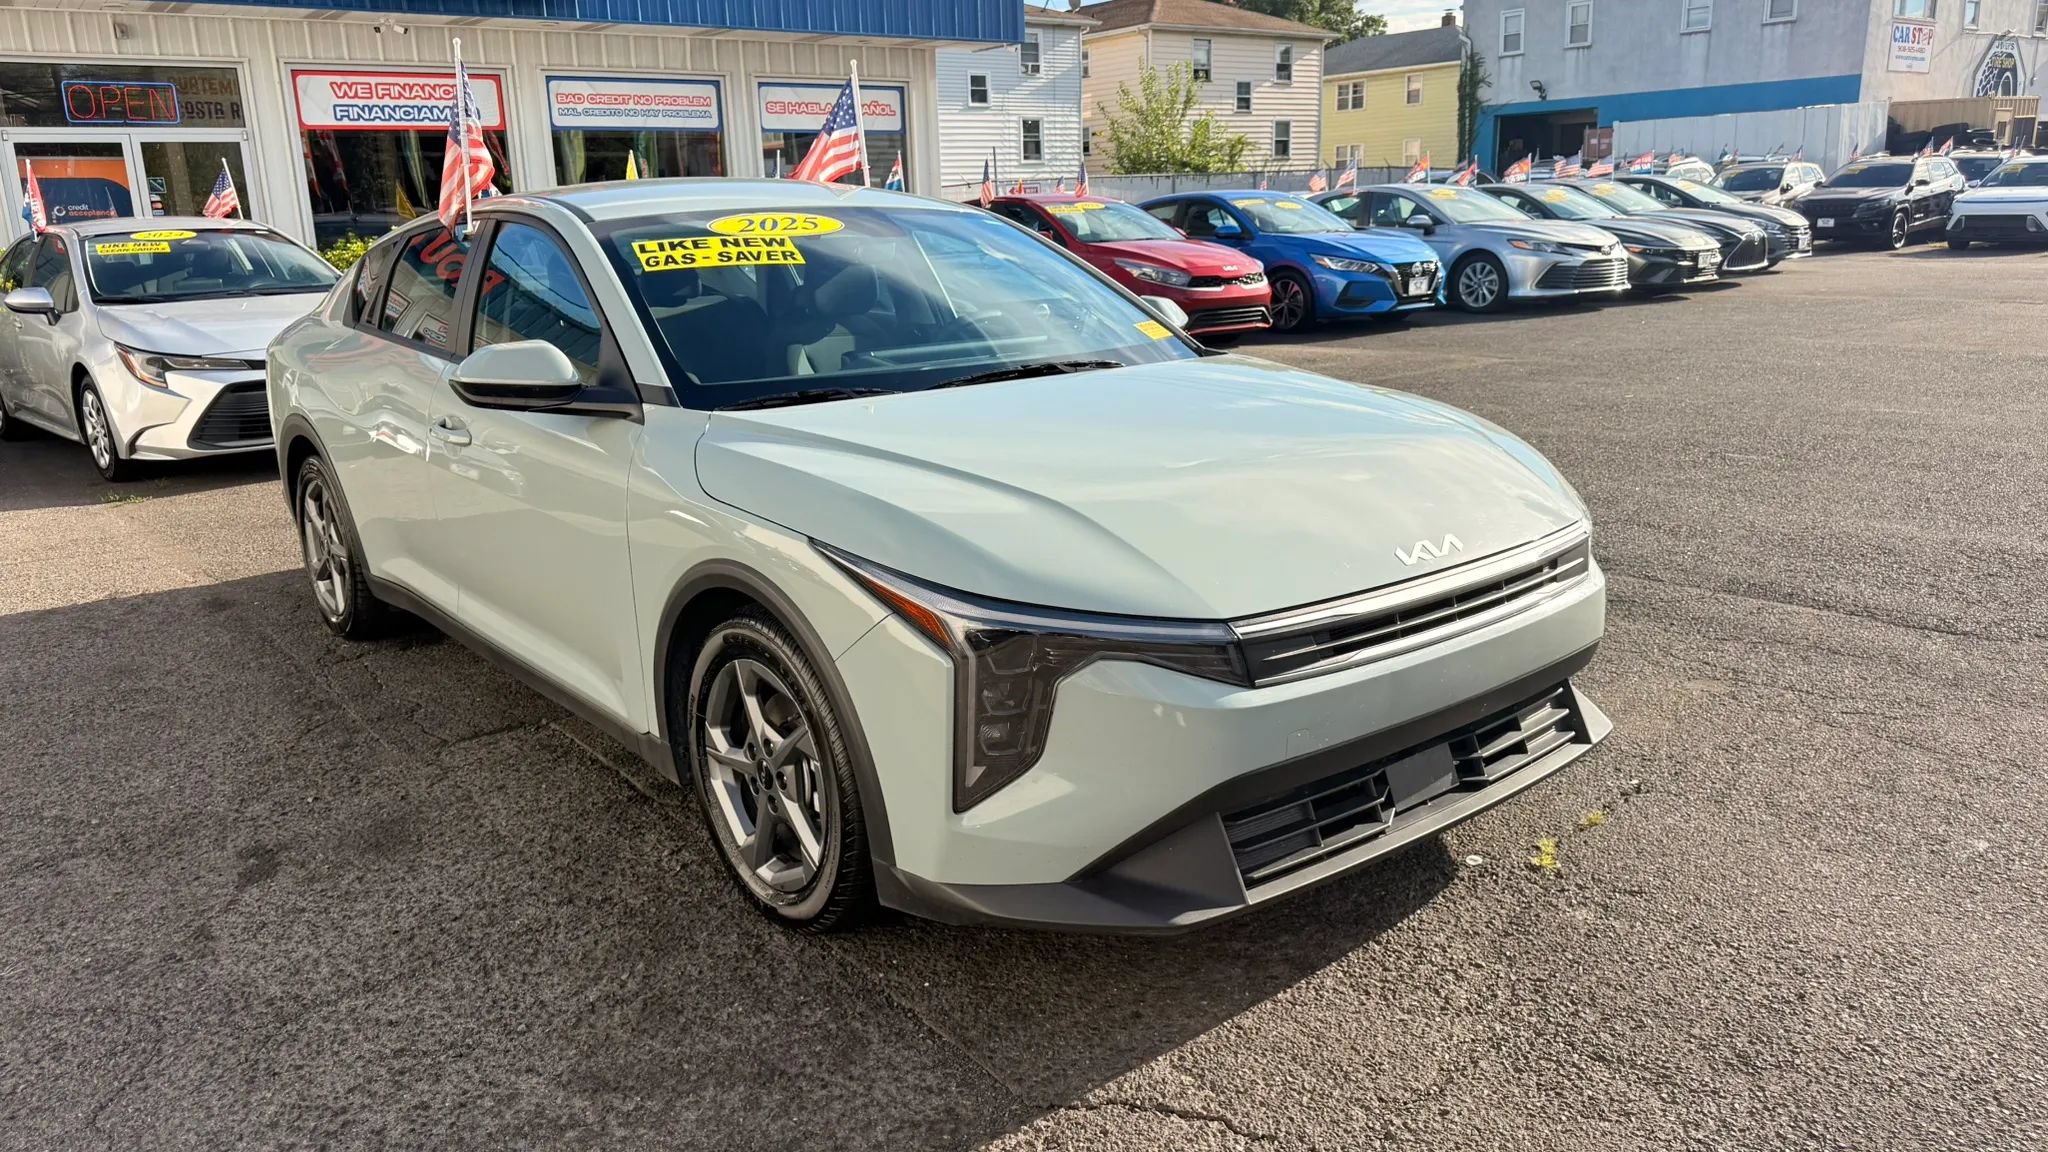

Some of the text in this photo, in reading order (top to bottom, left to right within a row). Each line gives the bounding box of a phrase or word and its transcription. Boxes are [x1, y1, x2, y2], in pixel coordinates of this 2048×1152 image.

[1893, 26, 1910, 44] CAR
[330, 82, 459, 100] WE FINANC
[556, 93, 712, 107] BAD CREDIT NO PROBLEM
[68, 85, 176, 120] OPEN
[766, 101, 785, 114] SE
[861, 100, 896, 116] AÑOL
[333, 104, 481, 122] FINANCIAM
[558, 108, 581, 117] MAL
[582, 108, 623, 117] CREDITO
[624, 109, 639, 117] NO
[662, 109, 712, 119] PROBLEMA
[738, 217, 818, 233] 2025
[638, 237, 786, 254] LIKE NEW
[644, 254, 697, 268] GAS
[717, 250, 798, 263] SAVER
[1393, 533, 1464, 567] KIA
